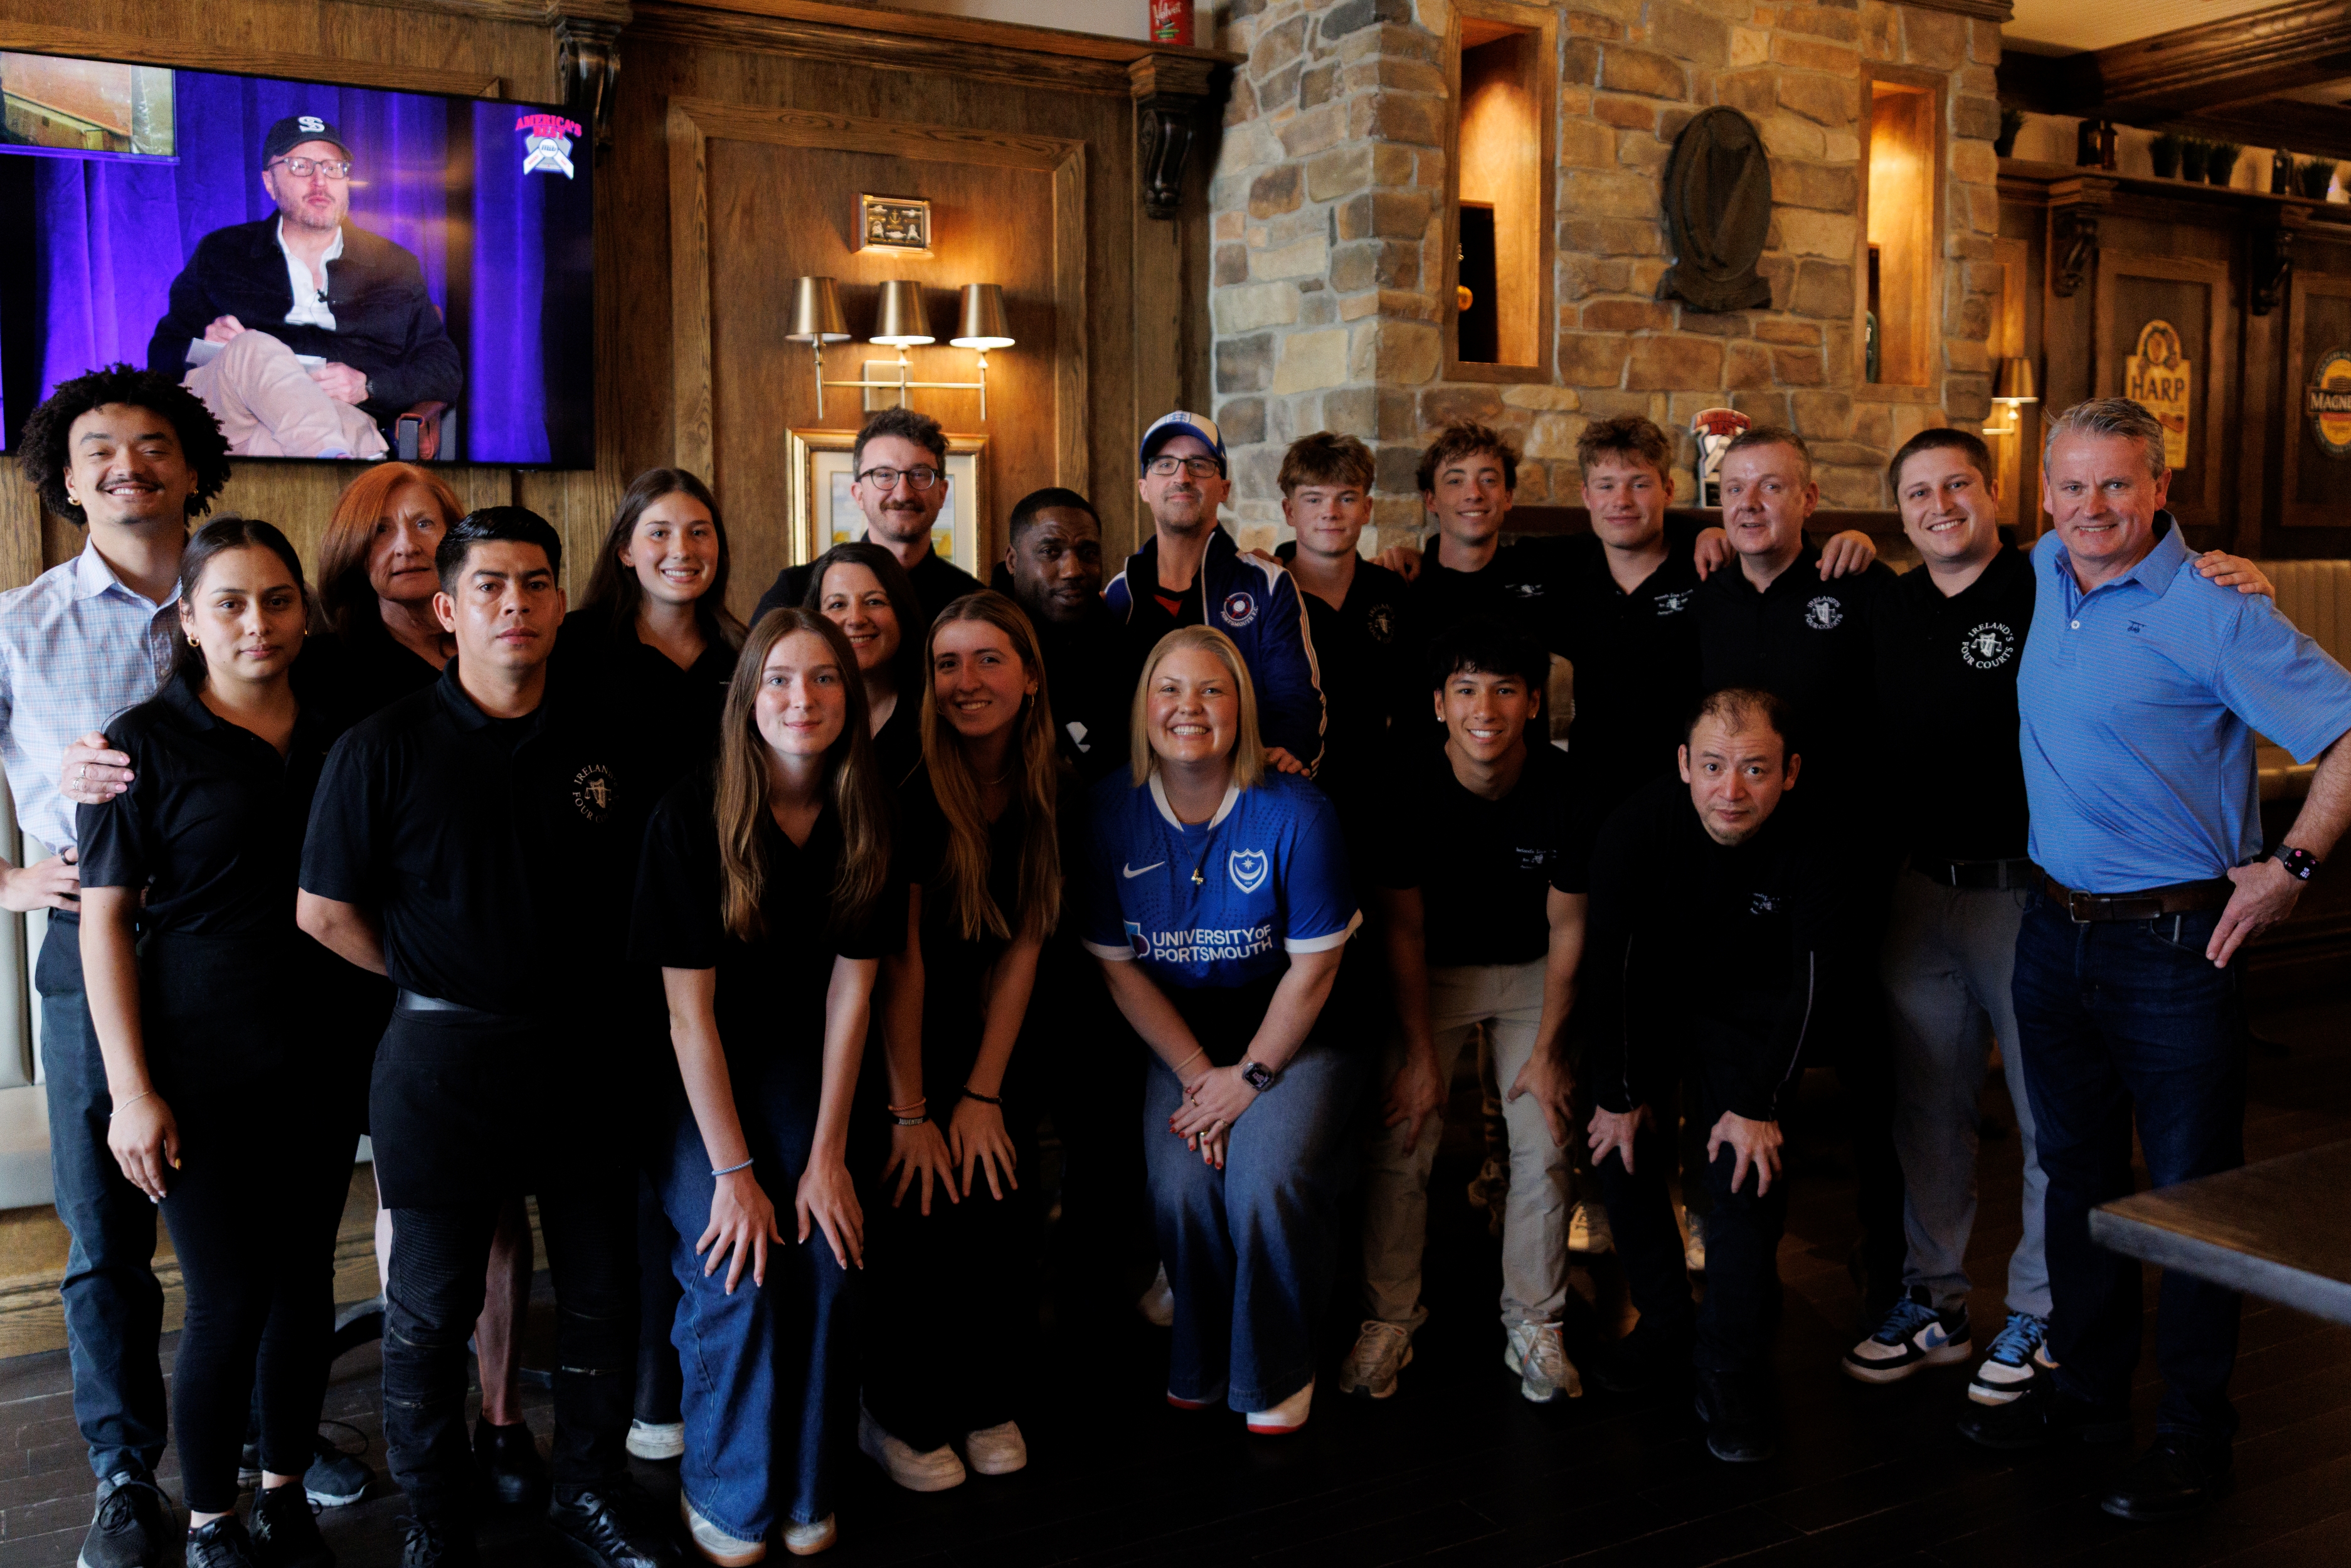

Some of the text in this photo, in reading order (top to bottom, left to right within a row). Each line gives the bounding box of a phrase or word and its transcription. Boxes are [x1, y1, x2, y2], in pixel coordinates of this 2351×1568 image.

[516, 114, 582, 137] AMERICA'S
[533, 126, 565, 140] BEST
[2131, 378, 2185, 403] HARP
[1807, 595, 1842, 608] IRELAND'S
[1819, 613, 1844, 629] COURTS
[1968, 622, 2015, 643] IRELAND'S
[1961, 641, 2014, 670] FOUR COURTS
[572, 792, 593, 821] FOUR
[1152, 924, 1271, 946] UNIVERSITY OF
[1154, 936, 1273, 963] PORTSMOUTH
